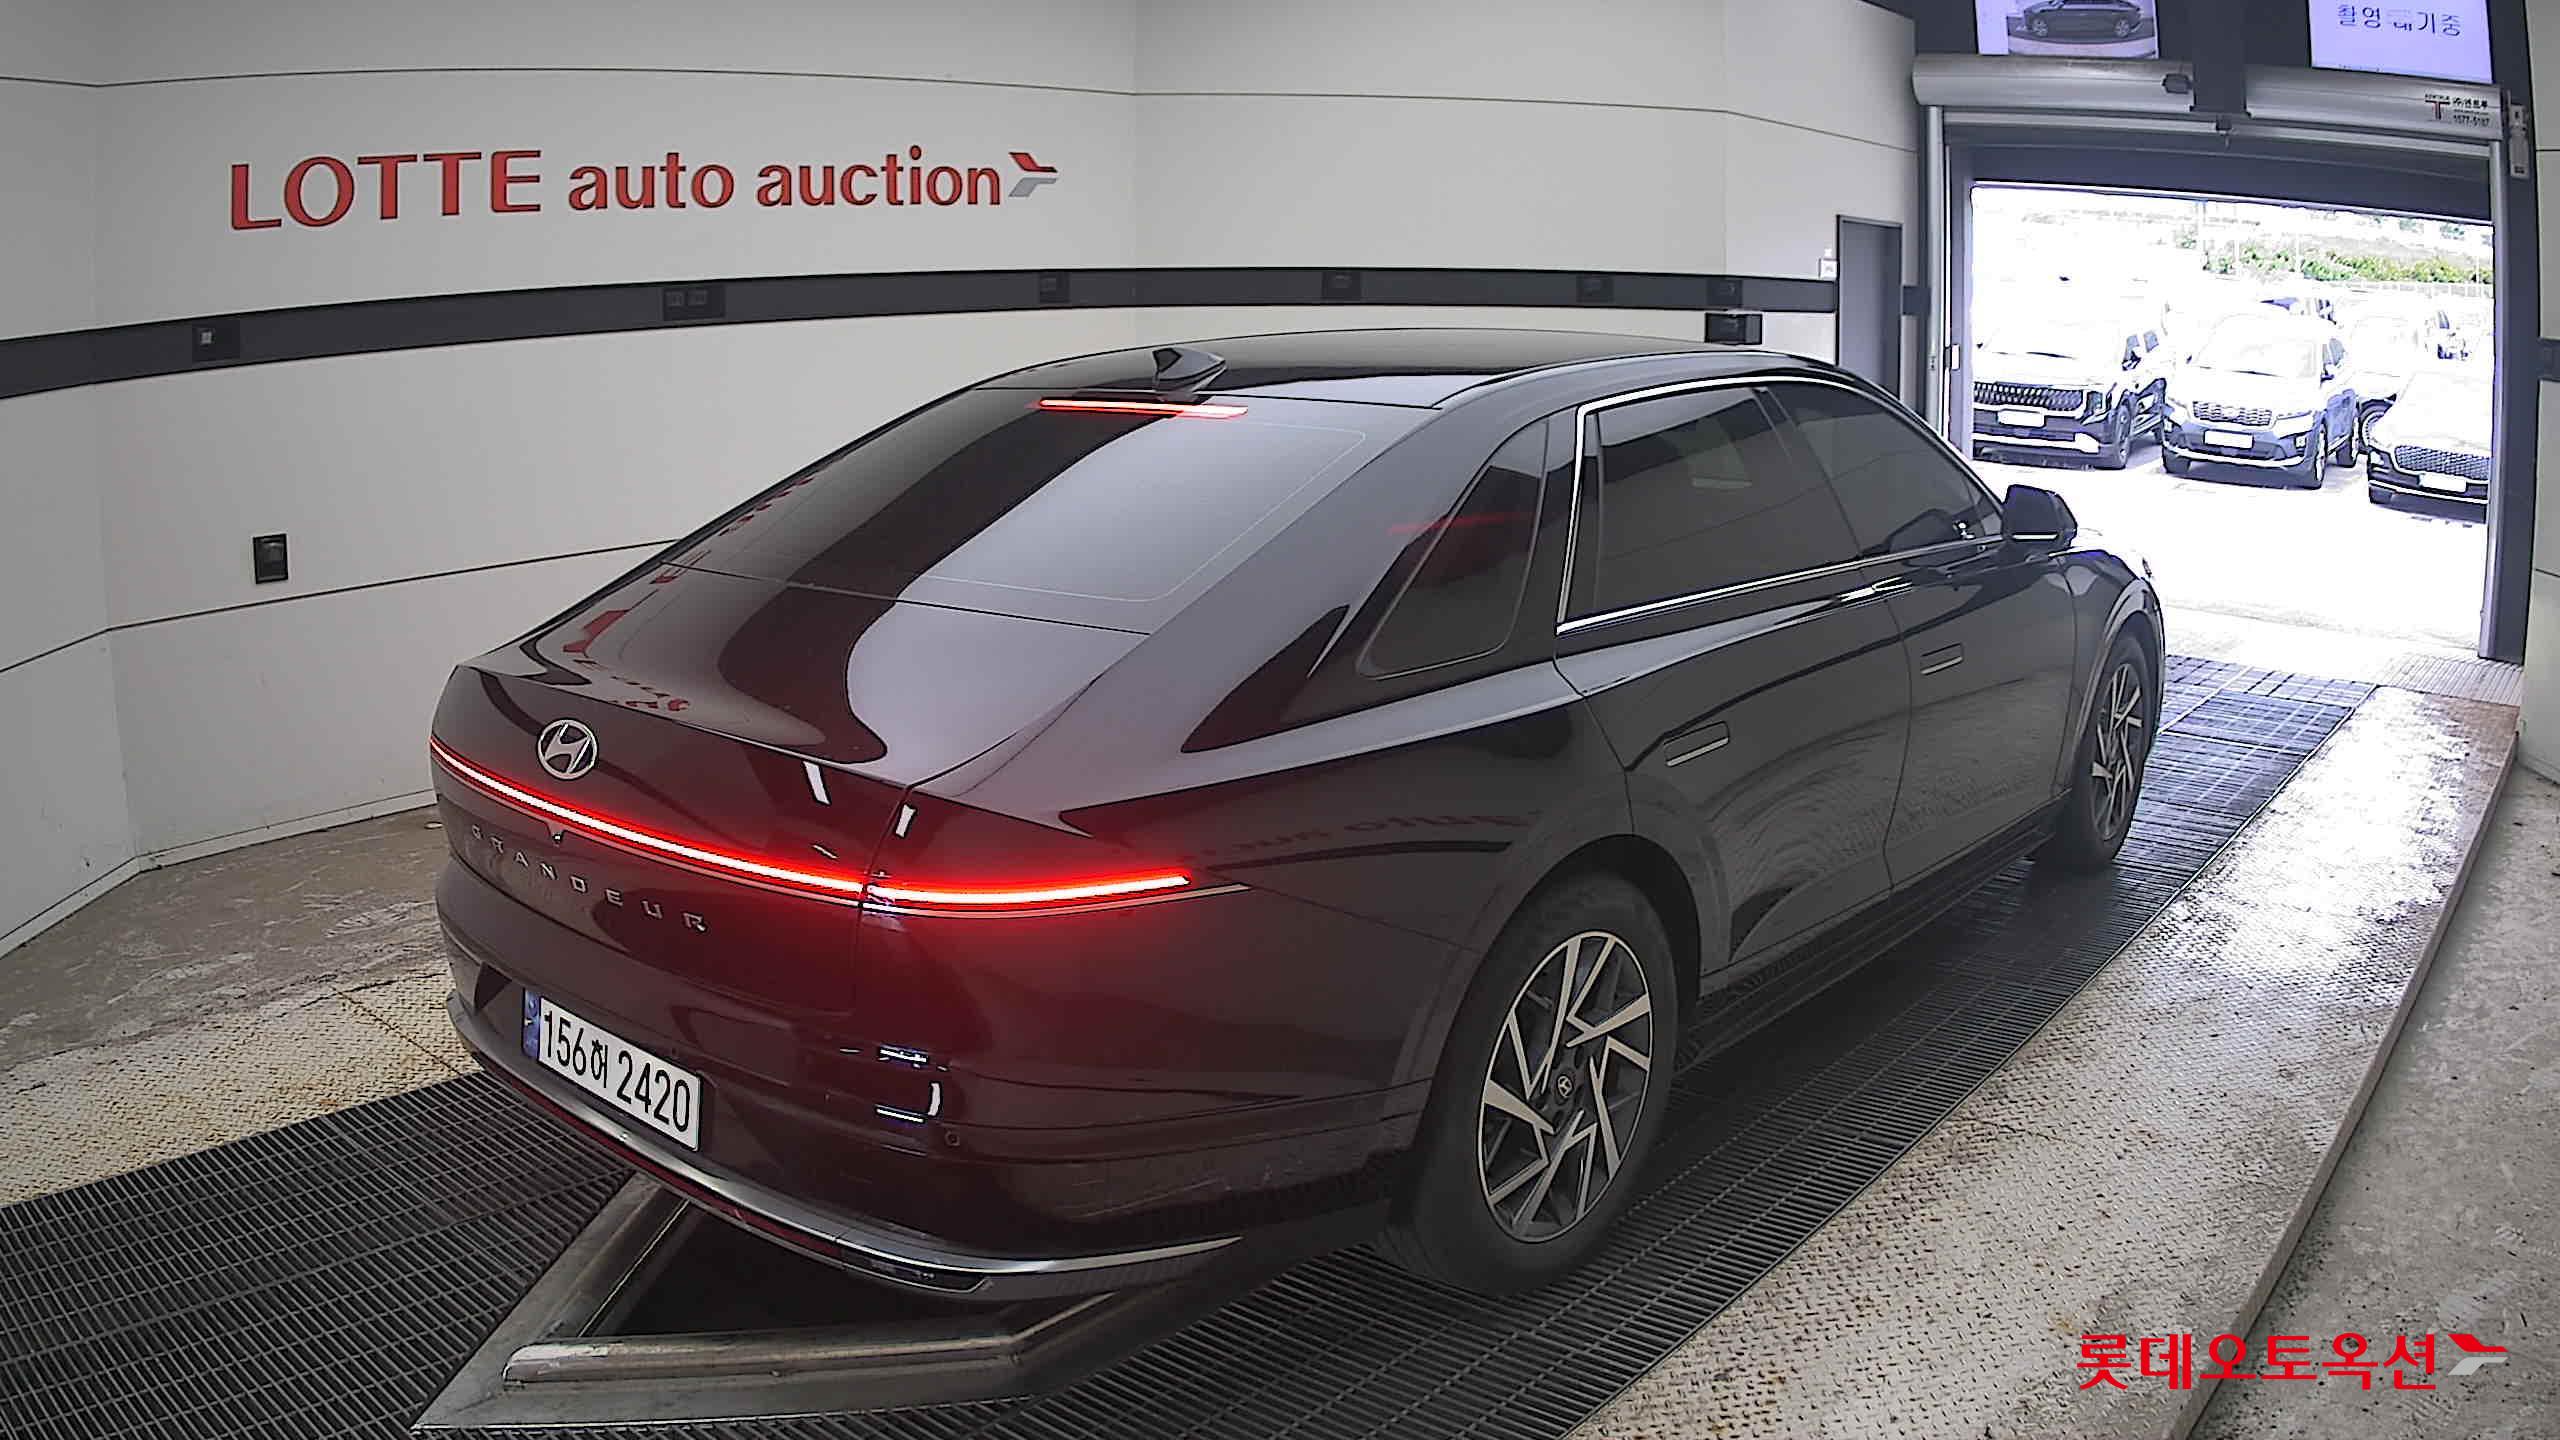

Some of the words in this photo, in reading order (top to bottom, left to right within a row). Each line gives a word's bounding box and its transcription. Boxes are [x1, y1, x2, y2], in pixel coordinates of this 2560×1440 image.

[230, 150, 542, 231] LOTTE
[568, 151, 735, 210] auto
[755, 146, 1001, 207] auction
[471, 824, 707, 932] GRANDEUR
[544, 1010, 609, 1089] 156허
[616, 1050, 691, 1132] 2420
